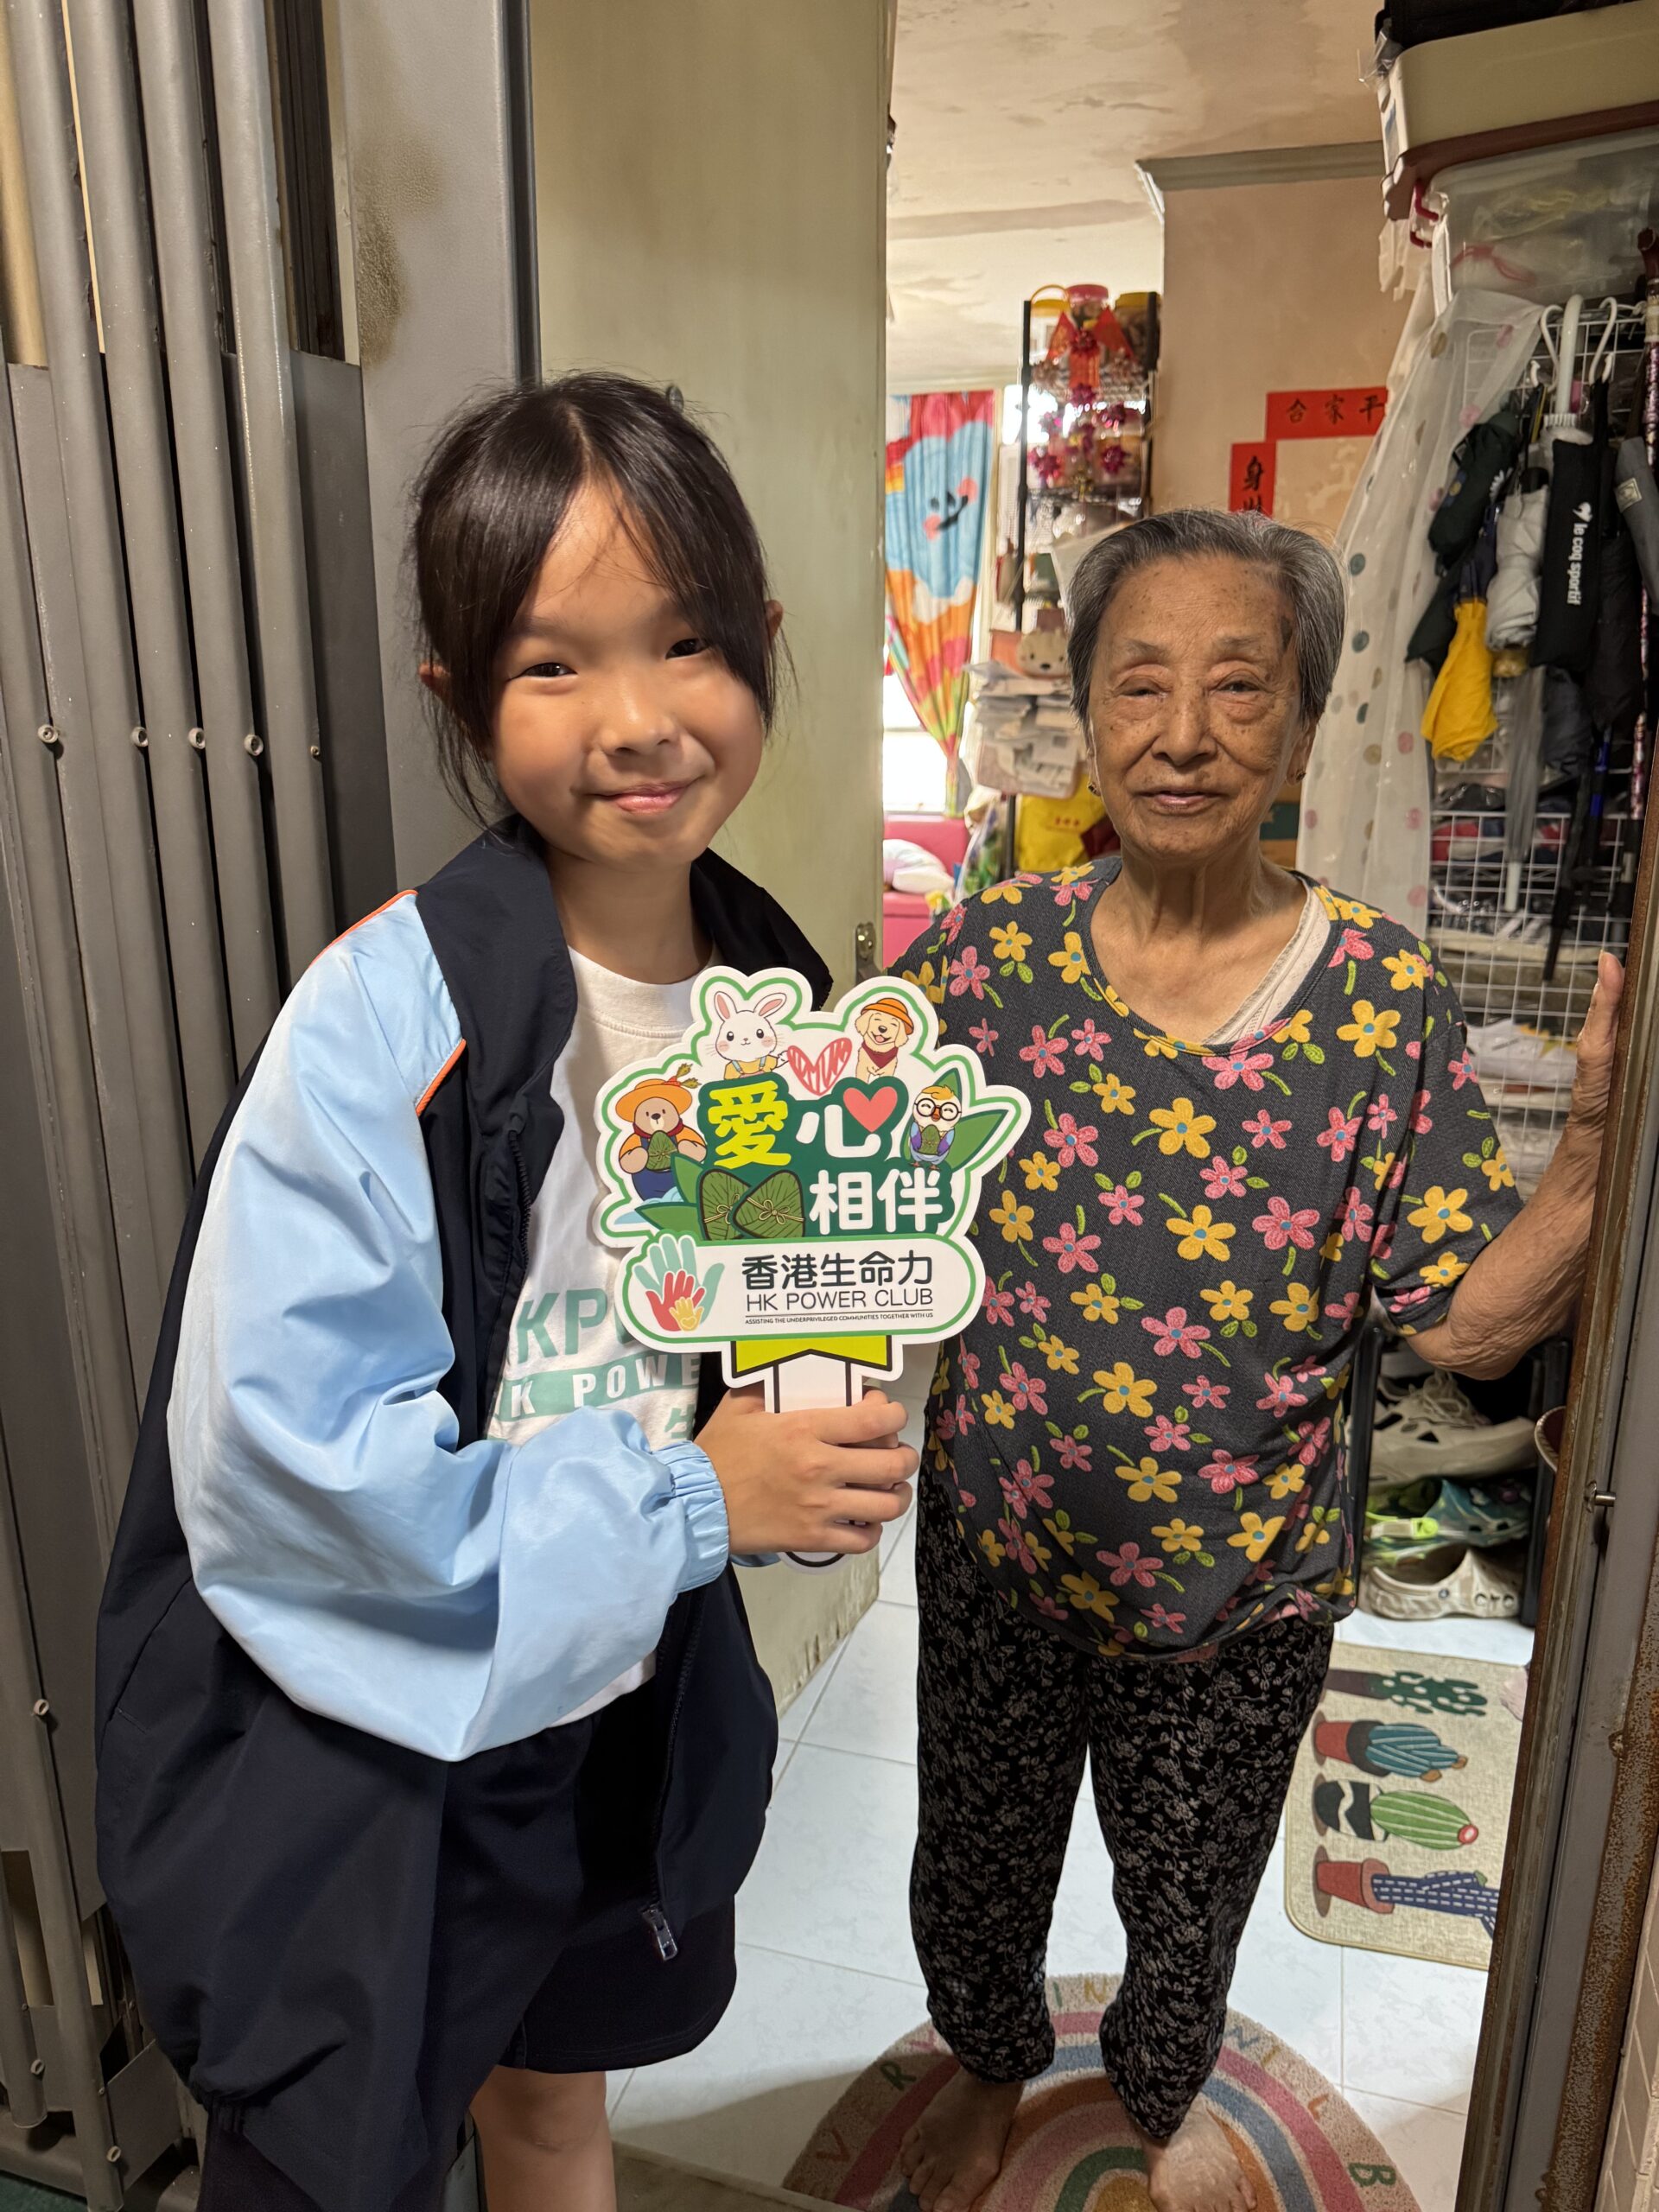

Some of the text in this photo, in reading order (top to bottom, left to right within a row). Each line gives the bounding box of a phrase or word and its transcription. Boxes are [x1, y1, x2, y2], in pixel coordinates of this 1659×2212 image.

[1287, 394, 1387, 424] 合家平
[1567, 523, 1589, 605] le coq sportif
[709, 1080, 893, 1169] 愛心
[809, 1168, 944, 1235] 相伴
[741, 1249, 933, 1290] 香港生命力
[747, 1287, 933, 1312] HK POWER CLUB
[572, 1353, 699, 1408] POWE
